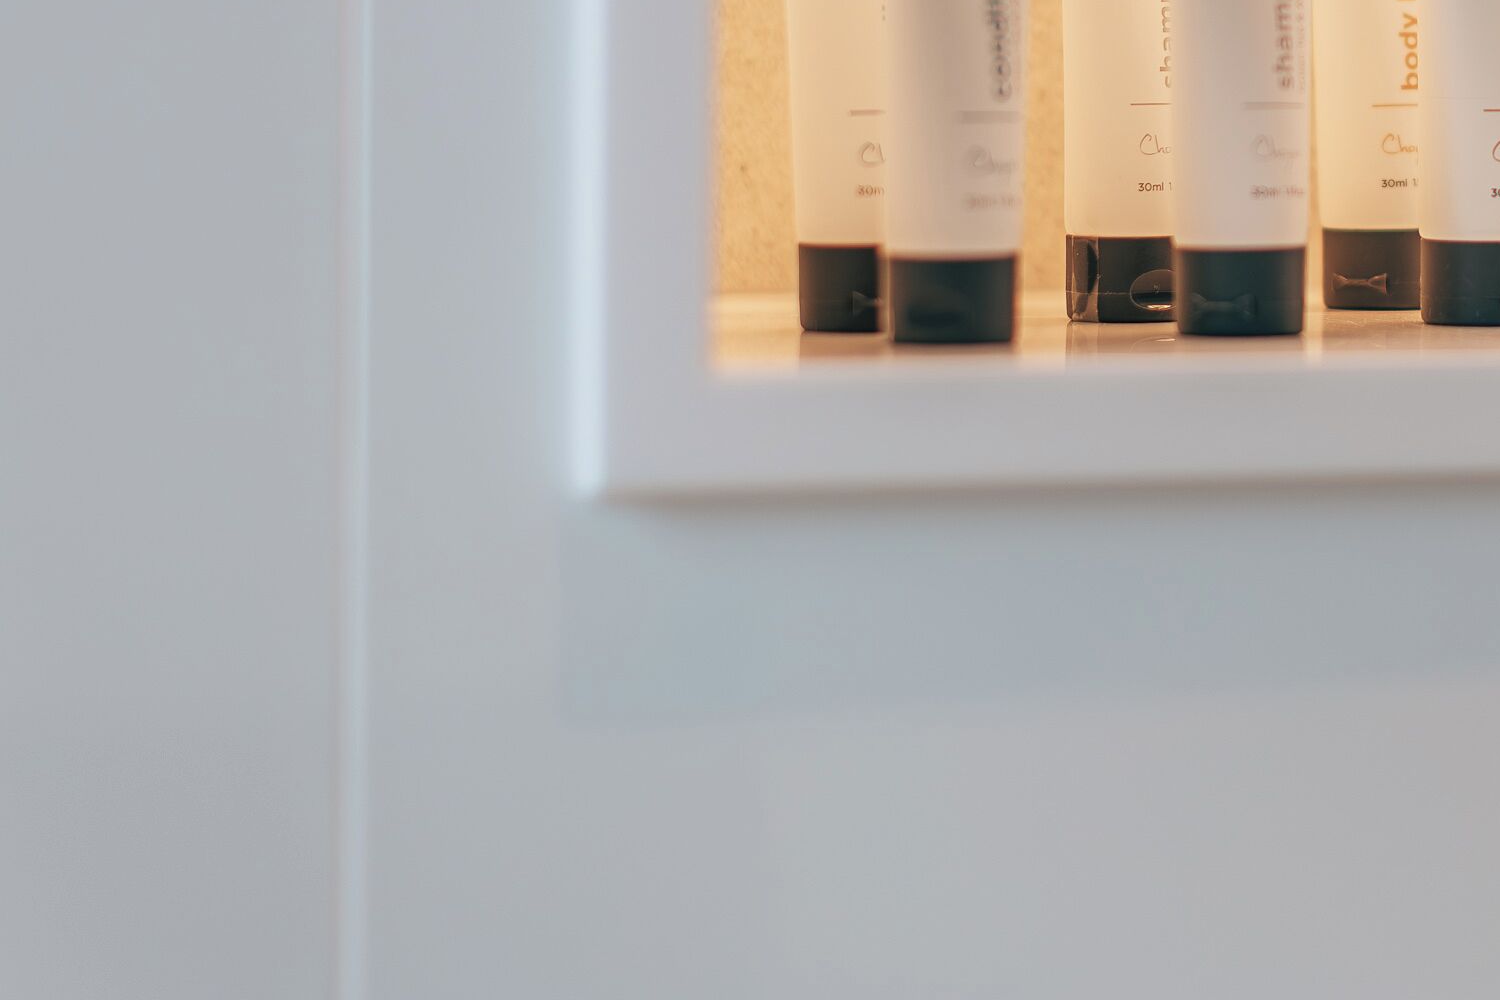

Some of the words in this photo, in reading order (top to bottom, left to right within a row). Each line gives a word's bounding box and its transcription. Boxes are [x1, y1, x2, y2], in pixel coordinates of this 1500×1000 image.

[1399, 12, 1419, 91] body
[1138, 181, 1165, 192] 30ml
[1381, 178, 1408, 188] 30ml
[856, 185, 885, 197] 30m
